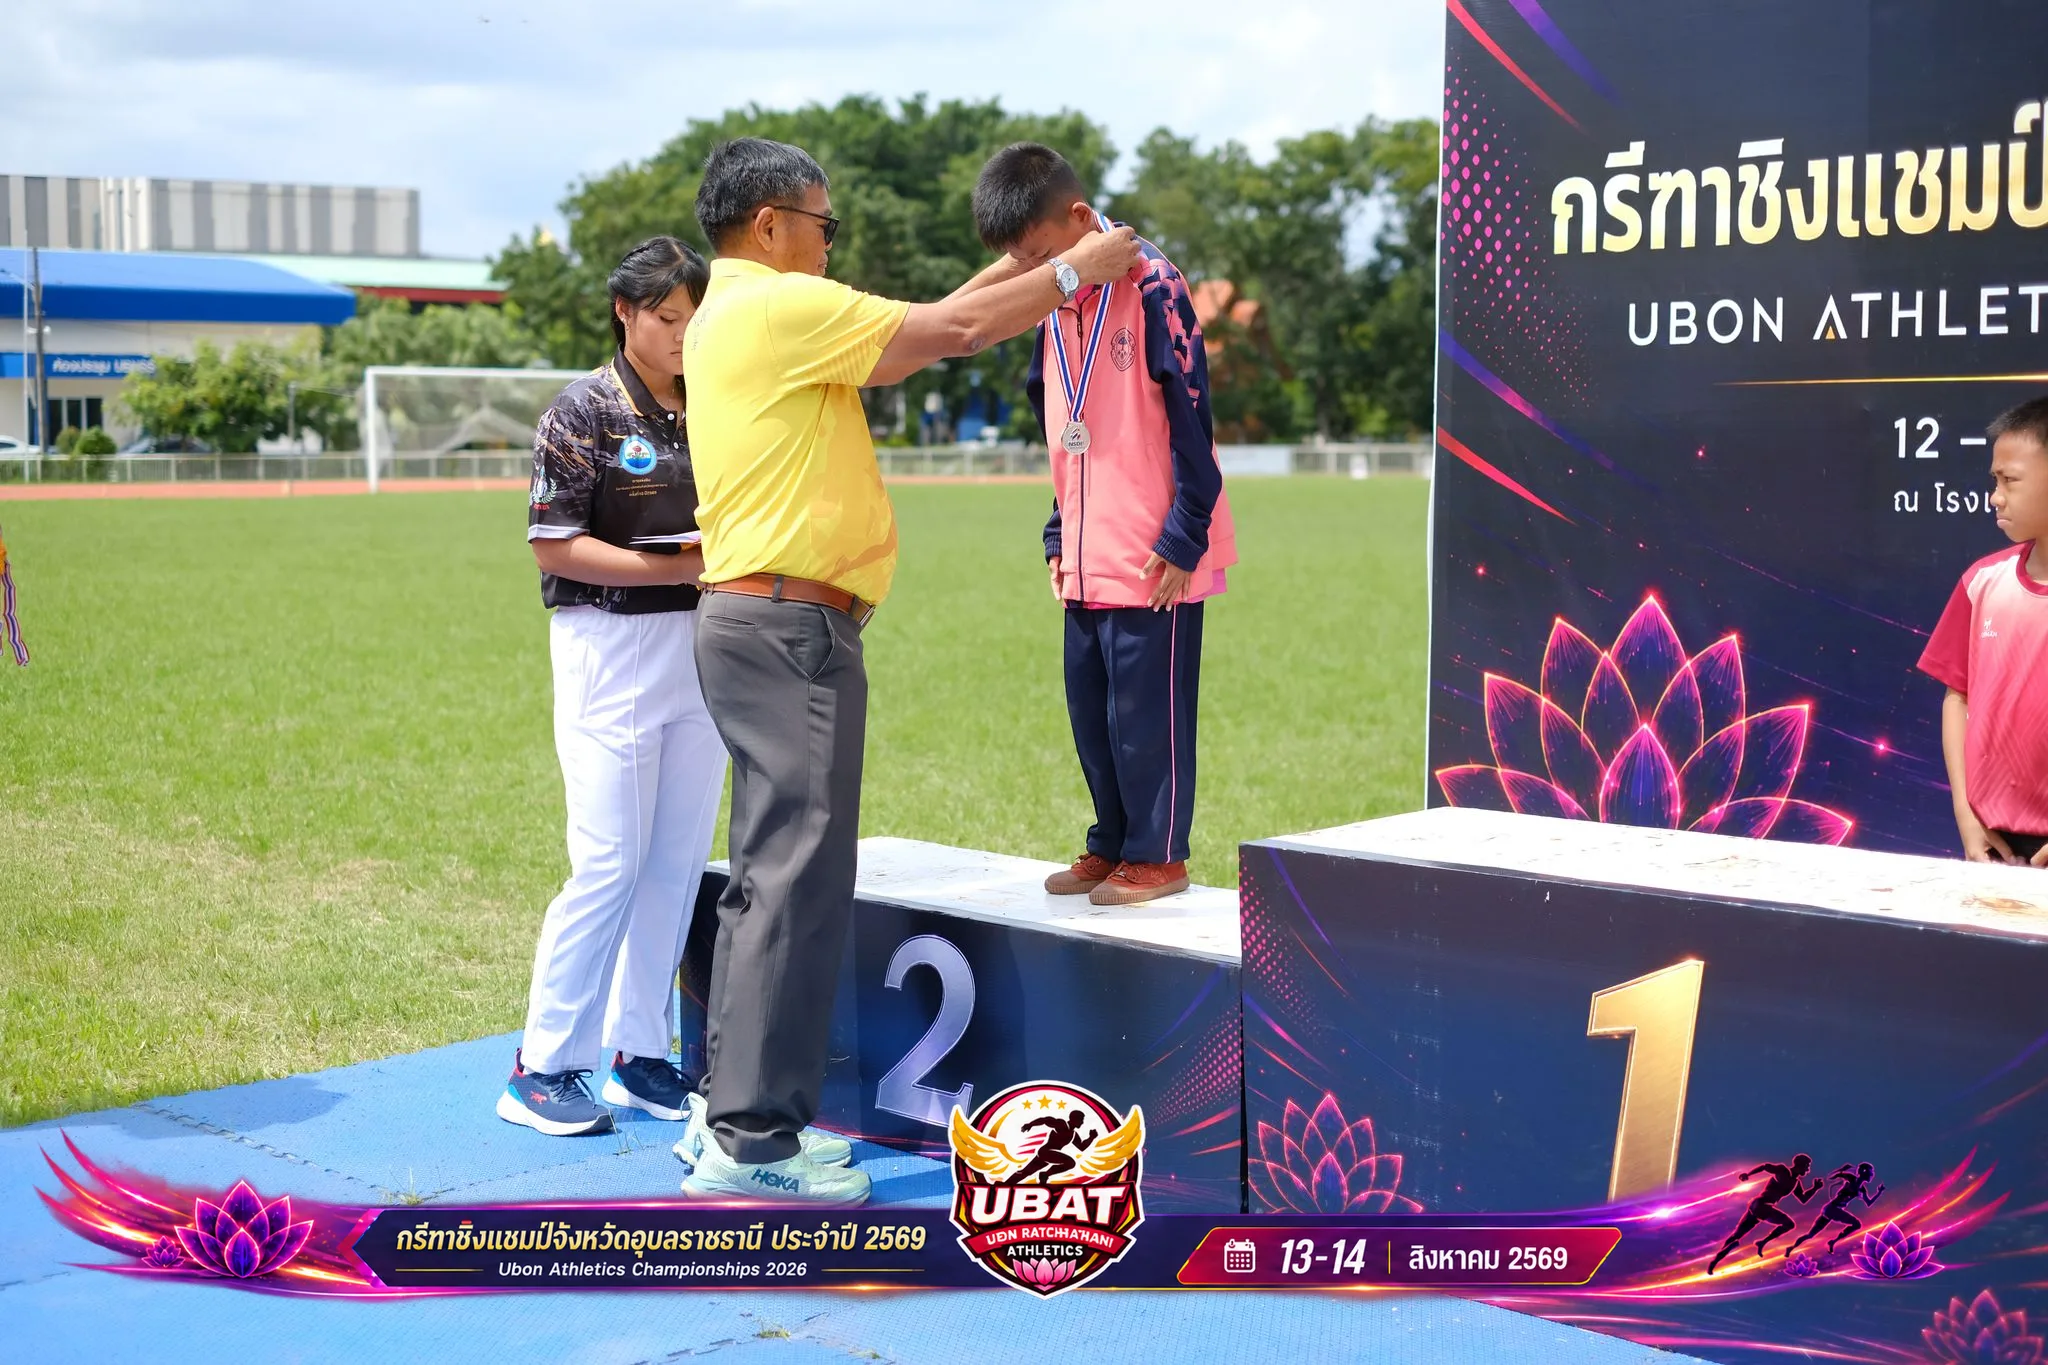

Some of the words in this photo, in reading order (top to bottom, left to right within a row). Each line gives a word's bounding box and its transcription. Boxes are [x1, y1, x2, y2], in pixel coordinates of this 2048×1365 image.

[1628, 296, 1784, 346] UBON
[1893, 416, 1940, 459] 12
[1893, 490, 1919, 513] ณ
[875, 934, 976, 1128] 2
[1587, 960, 1704, 1203] 1
[751, 1168, 800, 1193] HOKA
